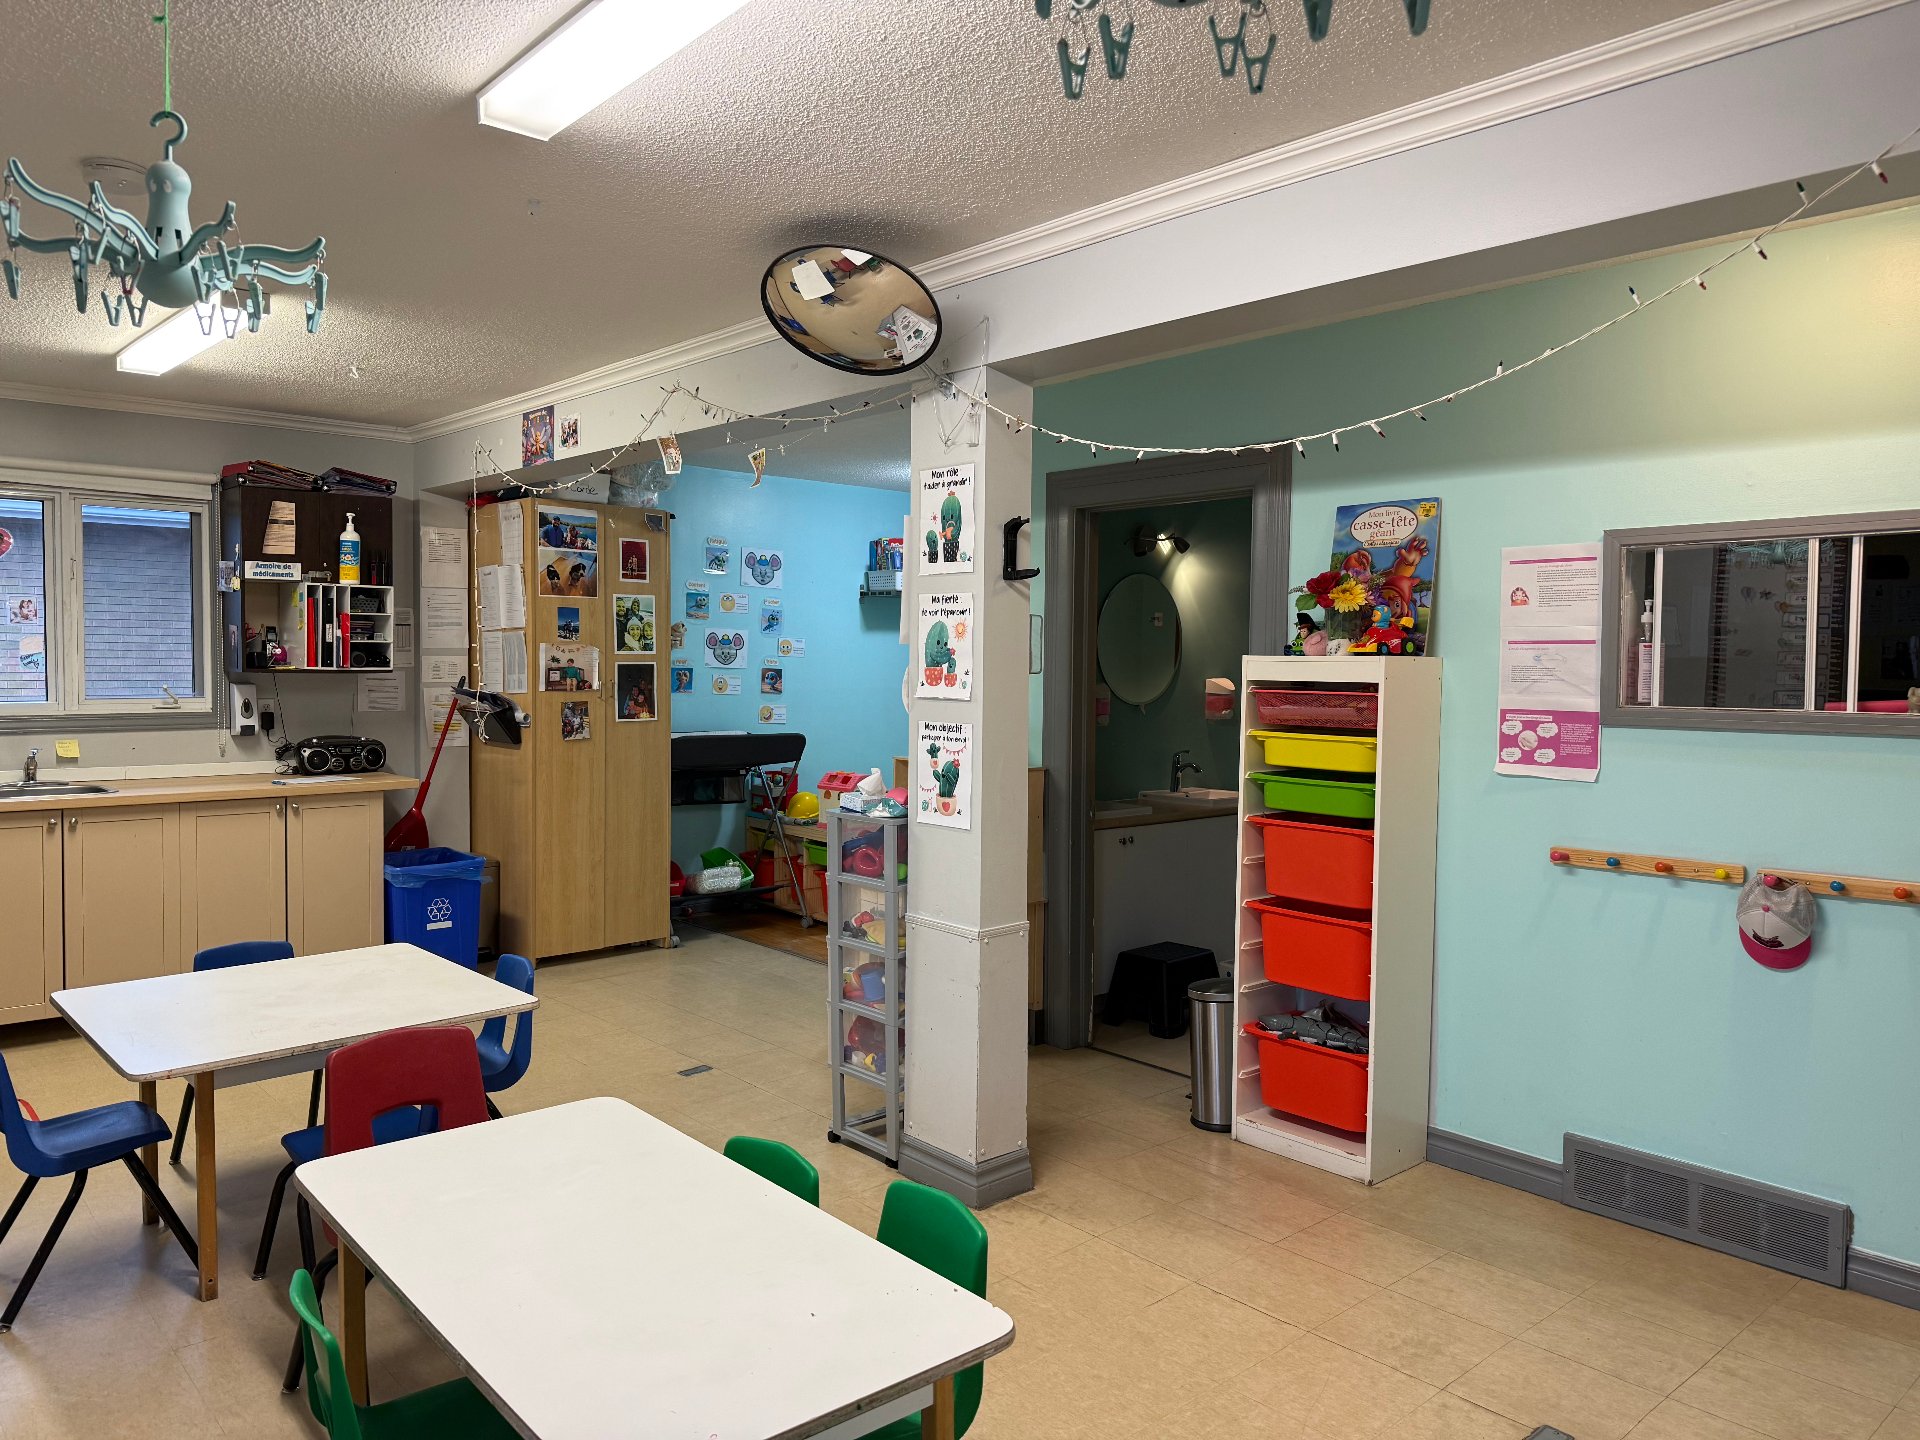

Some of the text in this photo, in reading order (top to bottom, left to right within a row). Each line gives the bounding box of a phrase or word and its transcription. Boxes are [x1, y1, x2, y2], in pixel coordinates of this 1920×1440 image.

[932, 471, 944, 479] Mon
[1385, 509, 1401, 517] livre
[1353, 515, 1415, 531] casse-tête
[1369, 528, 1396, 541] géant
[255, 561, 282, 569] Armoire
[252, 570, 294, 578] médicaments
[932, 596, 940, 604] Ma
[925, 722, 937, 731] Mon
